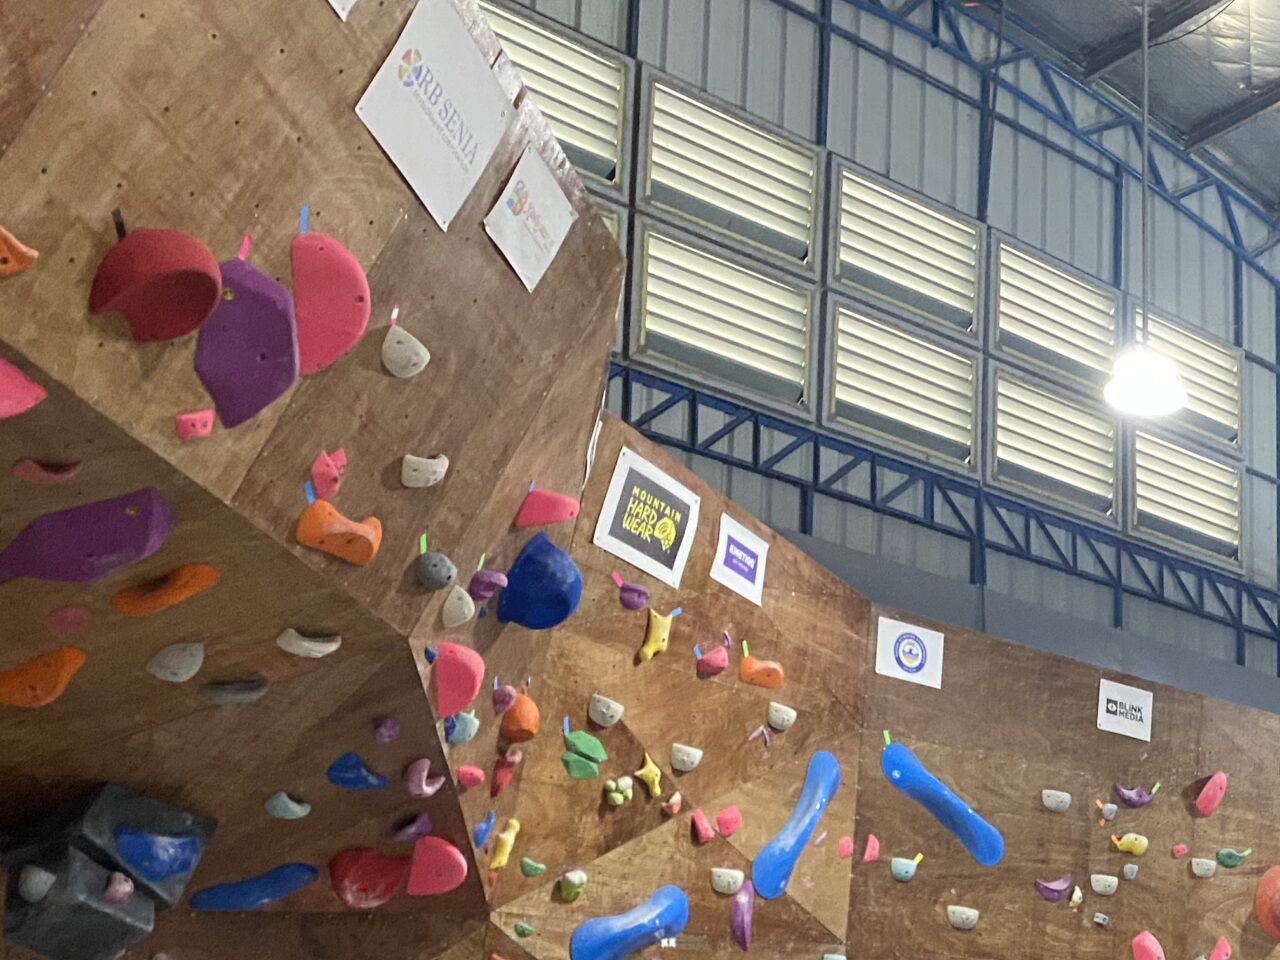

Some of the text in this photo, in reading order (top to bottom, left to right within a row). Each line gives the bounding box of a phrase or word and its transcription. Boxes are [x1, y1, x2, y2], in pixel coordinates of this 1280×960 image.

[626, 496, 657, 525] HARD
[632, 485, 681, 523] MOUNTAIN
[622, 512, 653, 543] WEAR
[1119, 710, 1143, 724] MEDIA
